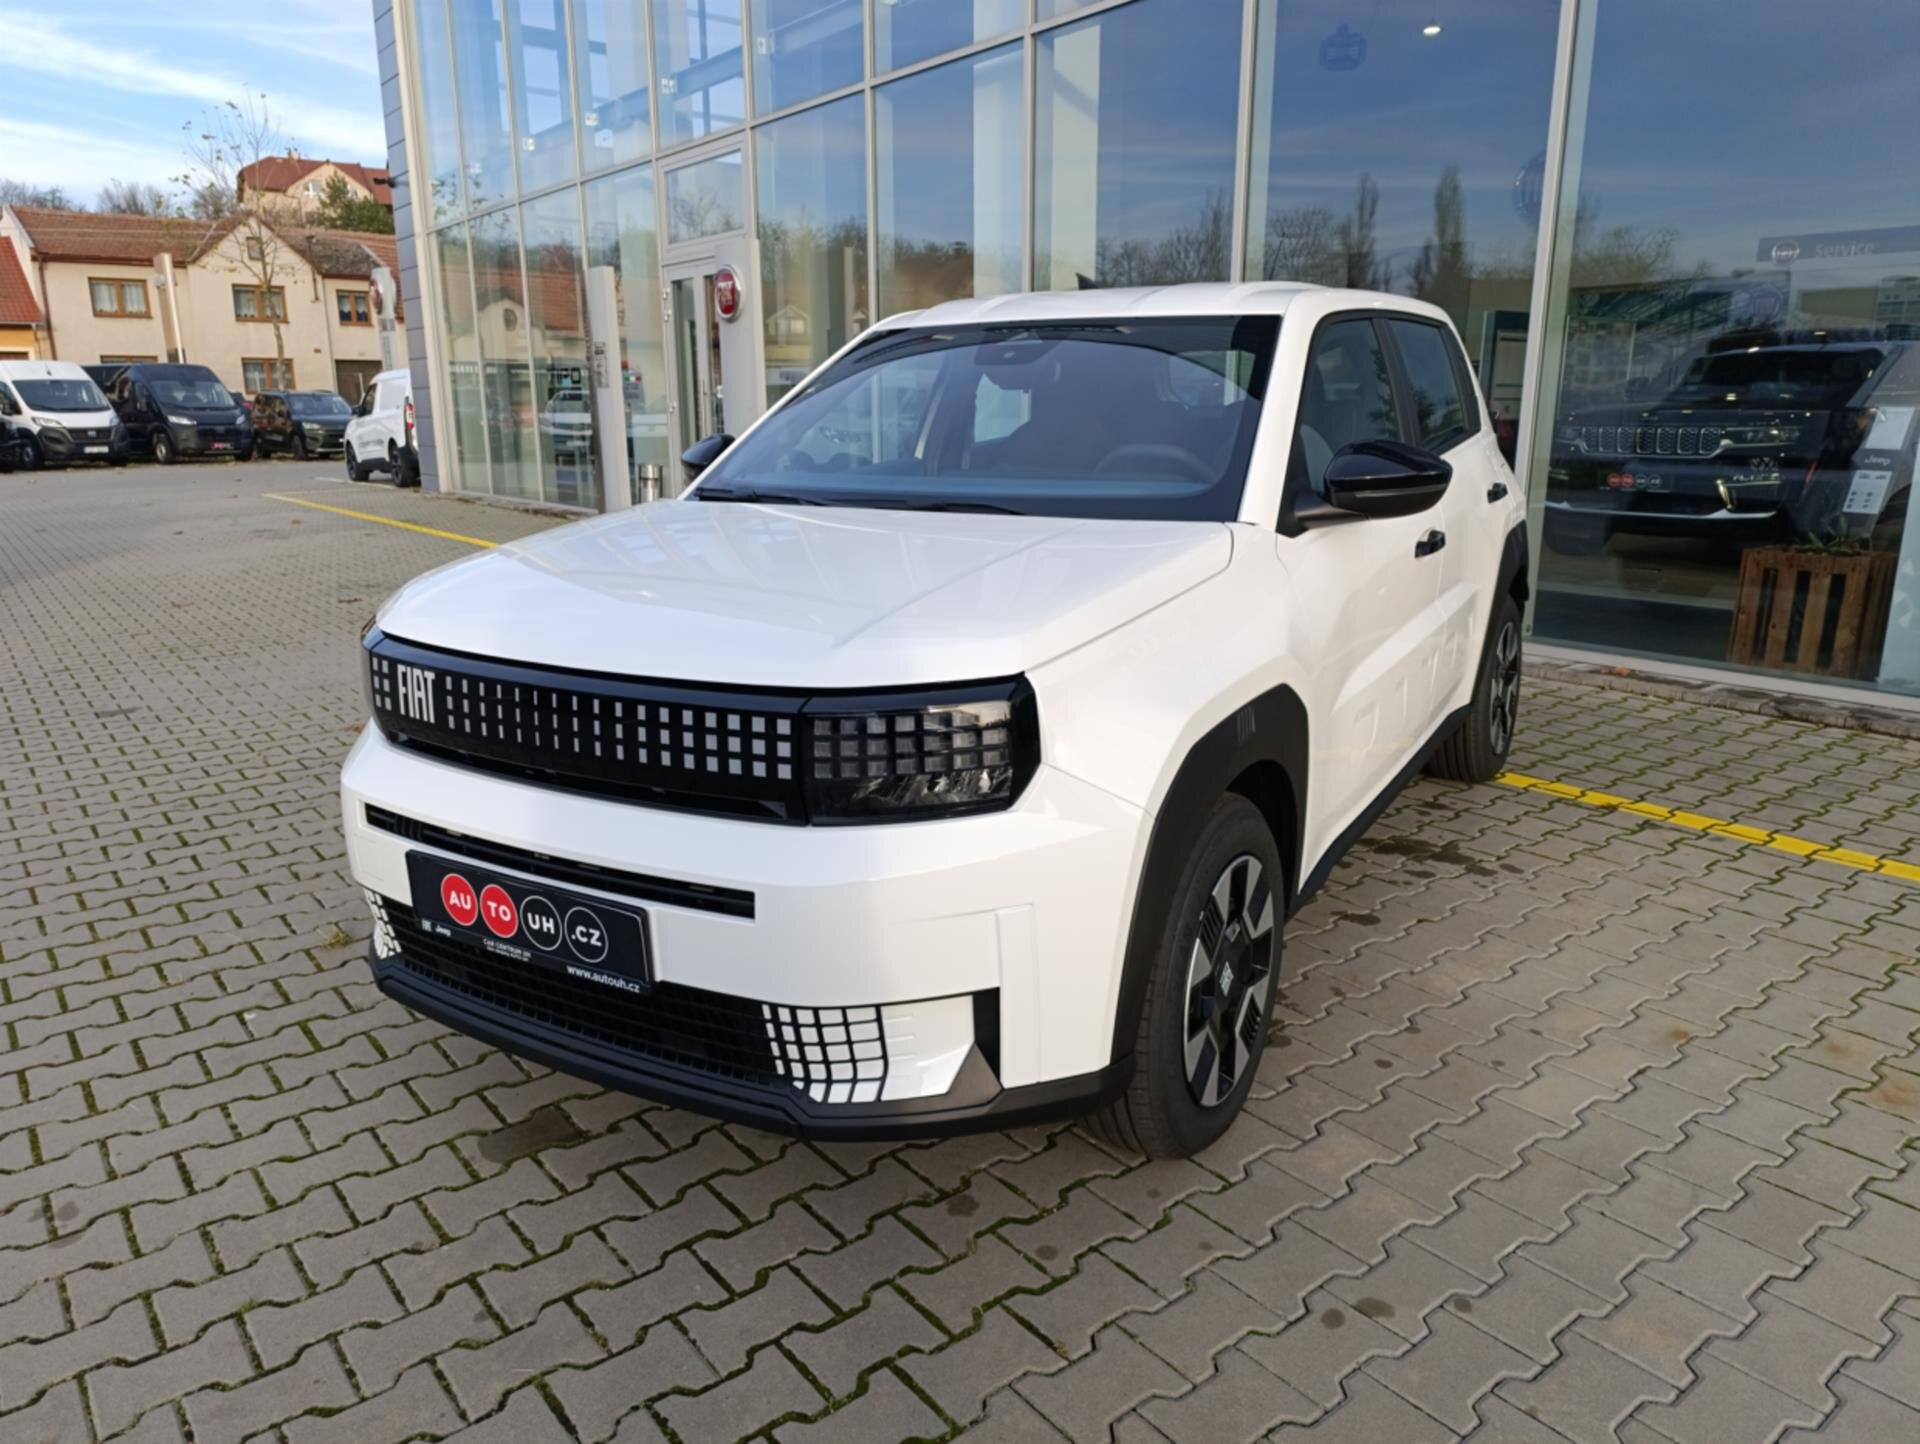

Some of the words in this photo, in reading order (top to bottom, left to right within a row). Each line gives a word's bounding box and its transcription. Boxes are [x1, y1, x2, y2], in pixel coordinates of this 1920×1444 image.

[1815, 240, 1875, 257] Service
[397, 663, 436, 724] FIAT
[449, 890, 472, 910] AU
[486, 901, 512, 921] TO
[526, 912, 555, 935] UH
[570, 925, 602, 947] .CZ
[566, 965, 641, 994] www.autouh.cz
